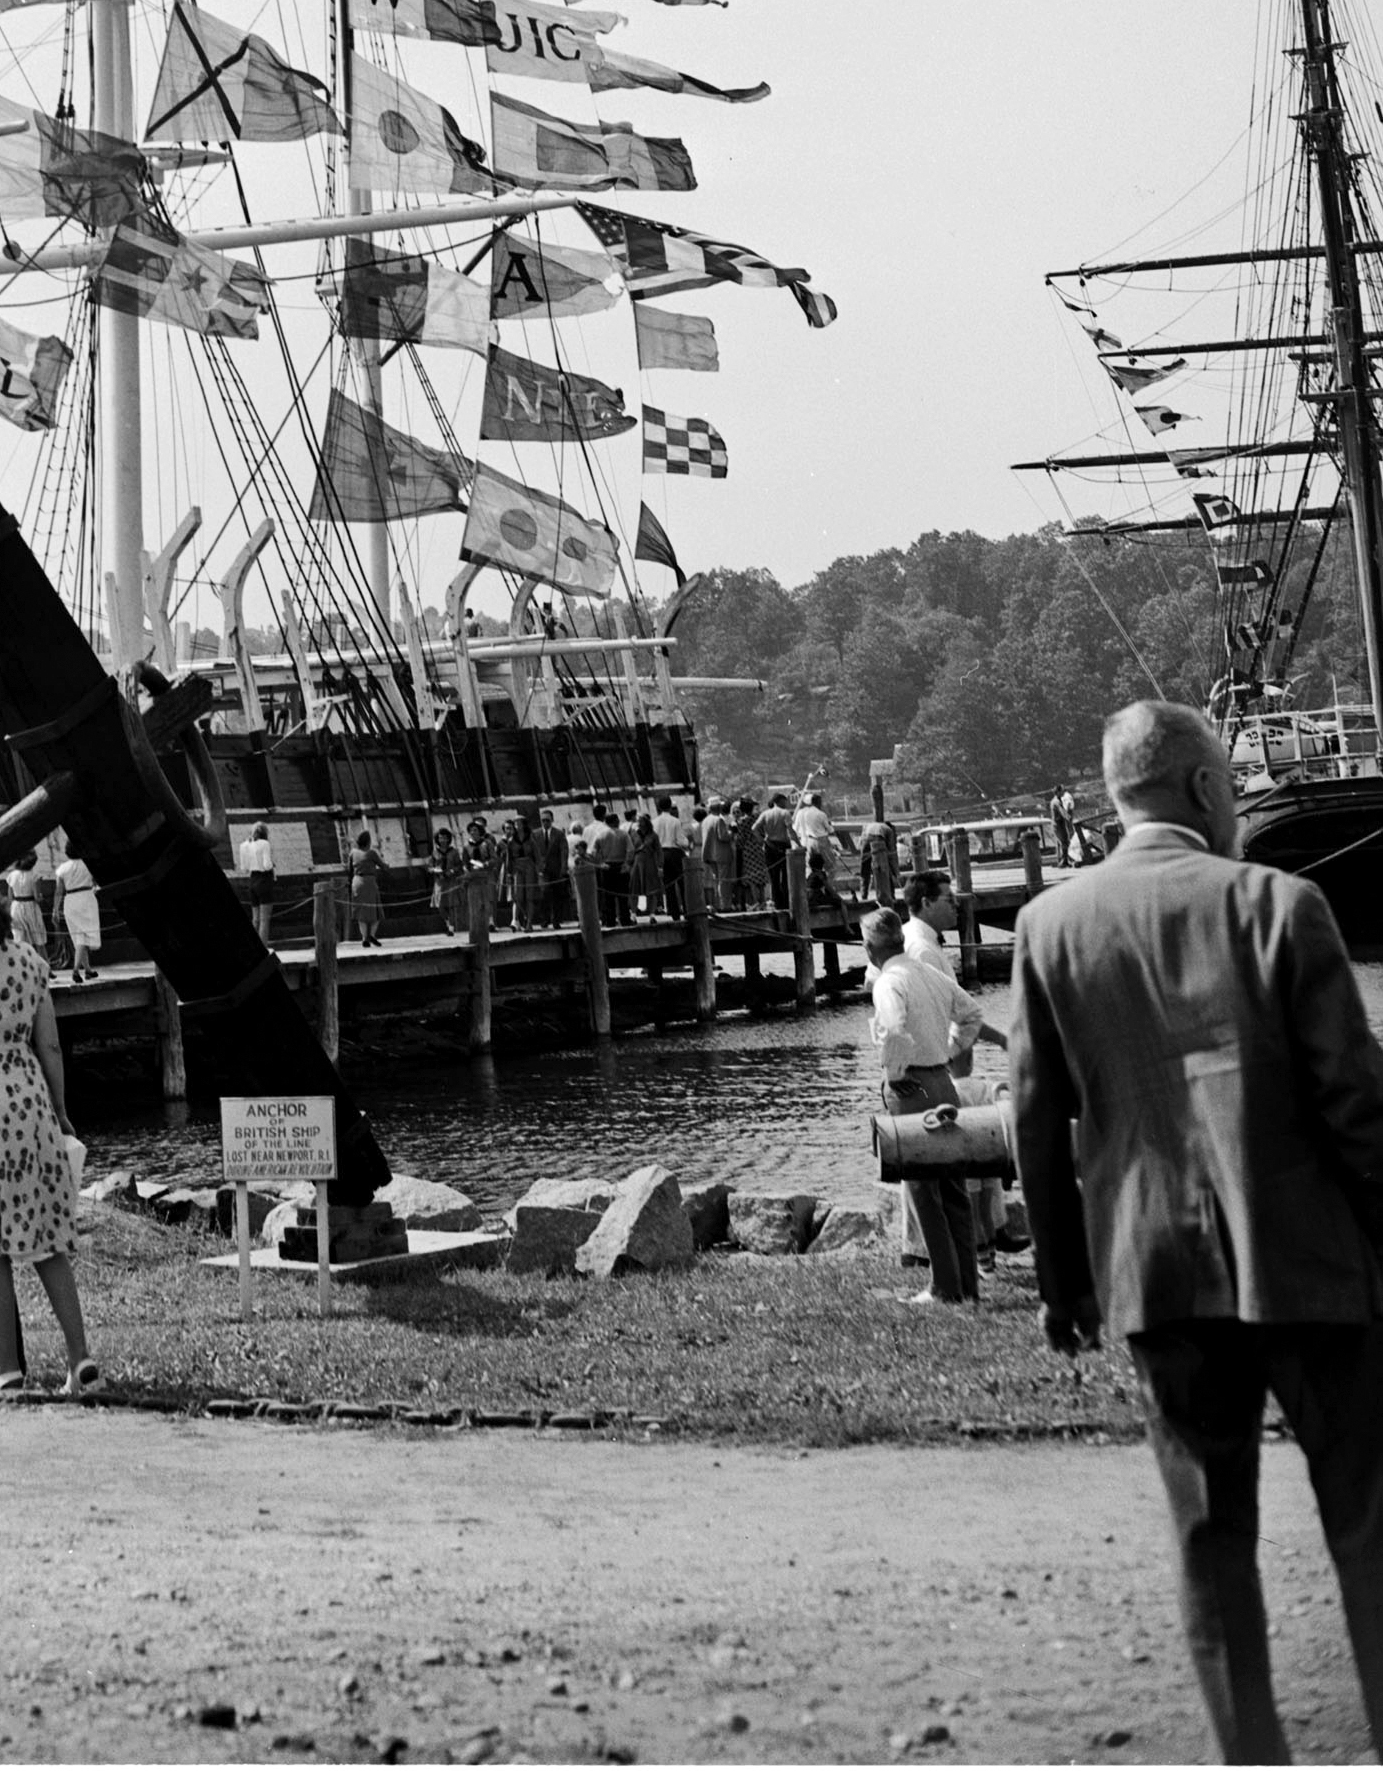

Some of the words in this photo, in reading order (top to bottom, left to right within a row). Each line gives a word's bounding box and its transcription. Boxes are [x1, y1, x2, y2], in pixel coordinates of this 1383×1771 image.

[494, 251, 544, 302] A
[246, 1103, 307, 1117] ANCHOR
[269, 1118, 285, 1126] OF
[234, 1126, 287, 1139] BRITISH
[292, 1126, 321, 1138] SHIP
[244, 1140, 258, 1149] OF
[263, 1140, 282, 1148] THE
[287, 1139, 311, 1148] LINE
[227, 1150, 248, 1163] LOST
[251, 1150, 273, 1162] NEAR
